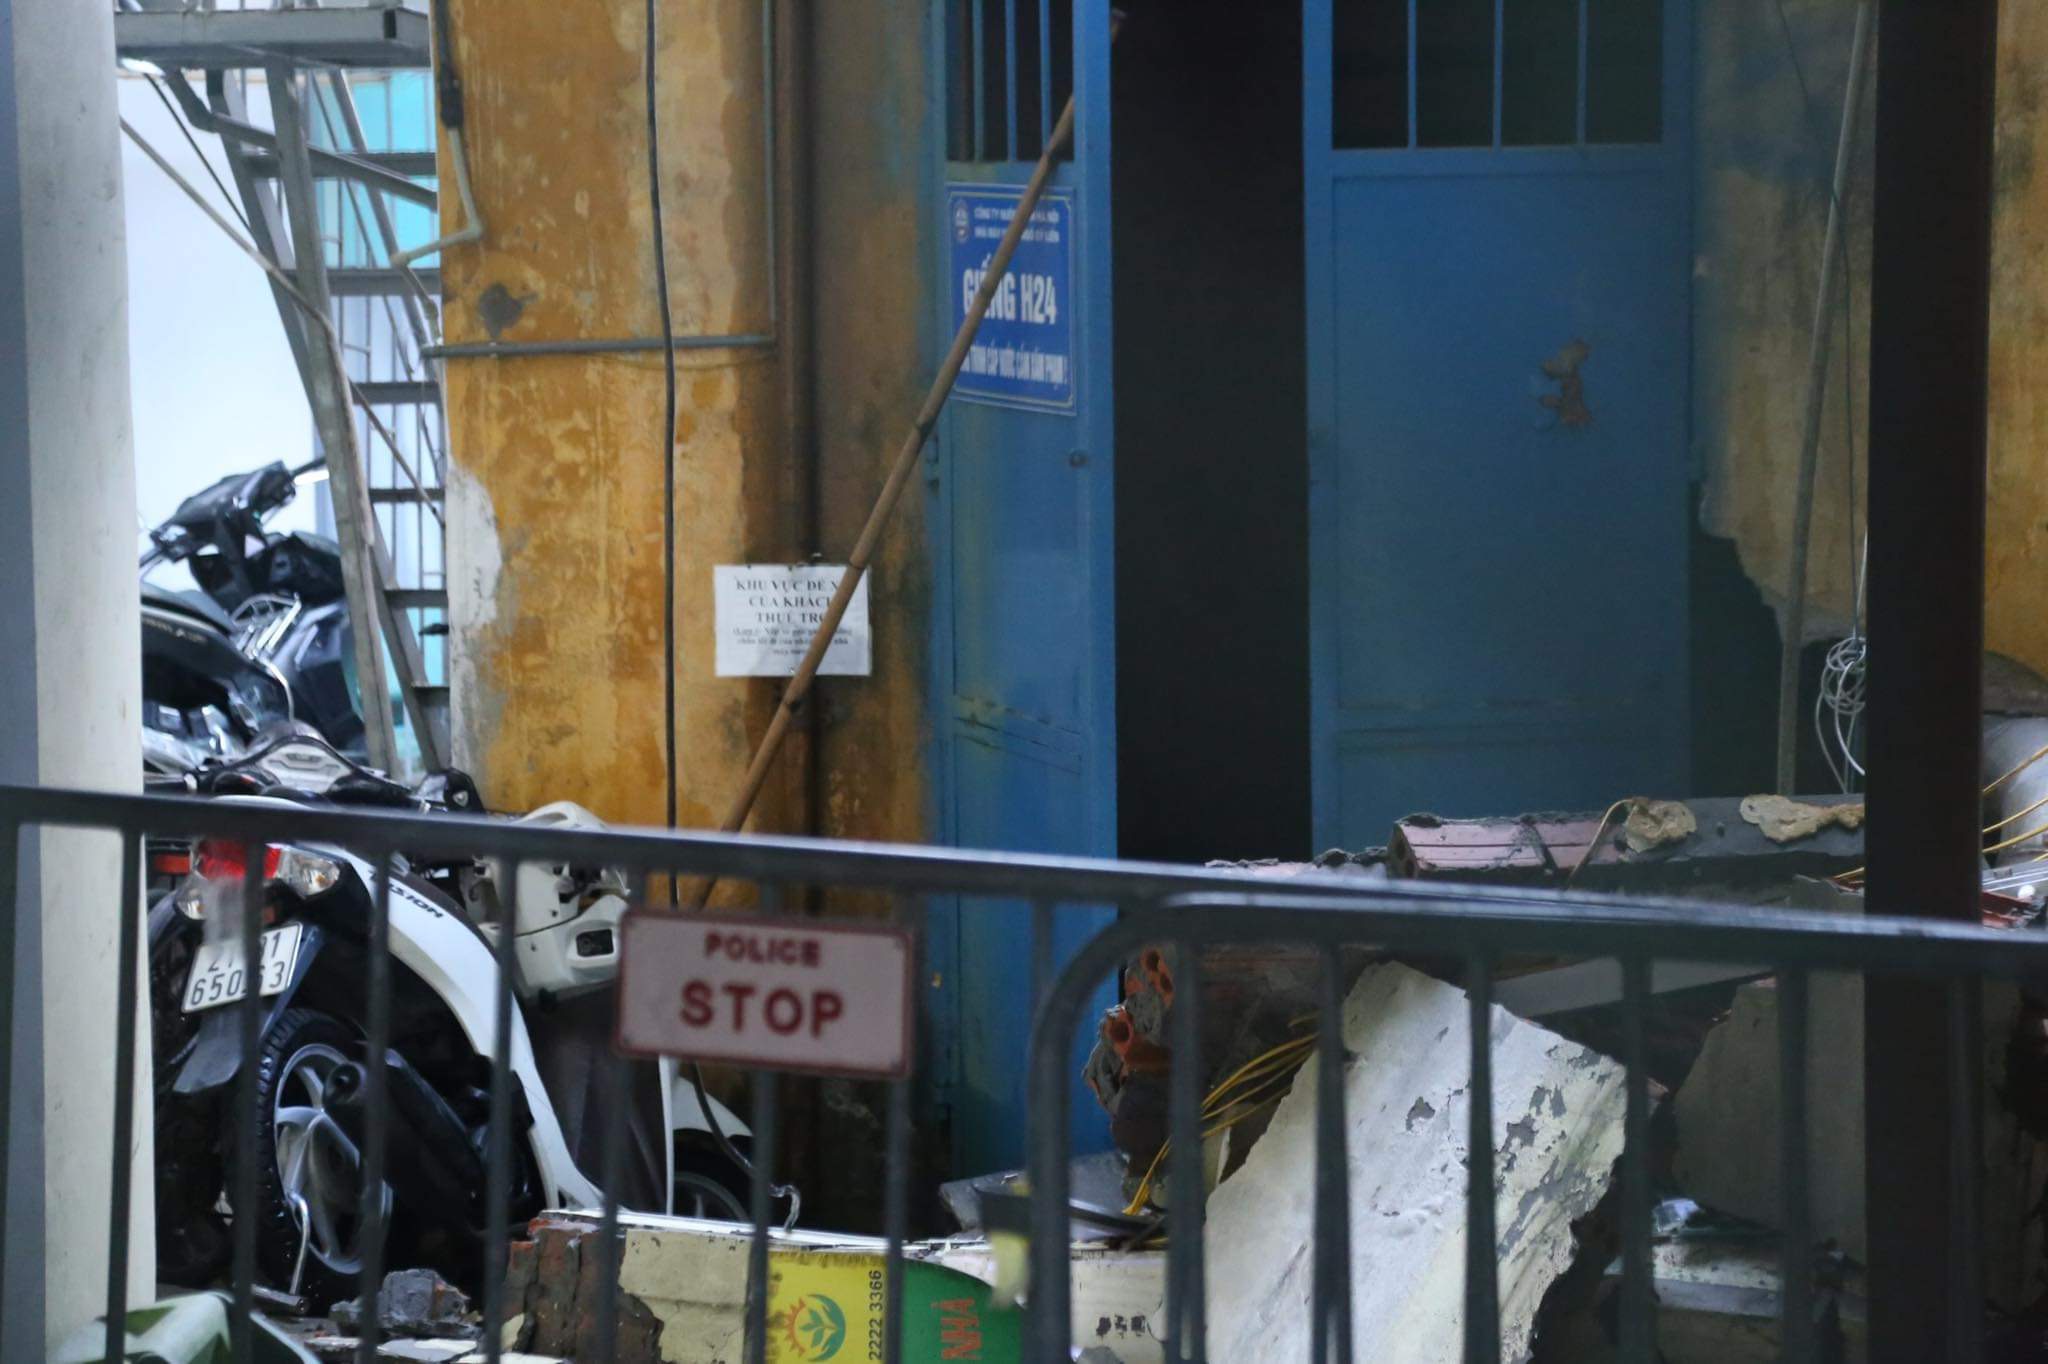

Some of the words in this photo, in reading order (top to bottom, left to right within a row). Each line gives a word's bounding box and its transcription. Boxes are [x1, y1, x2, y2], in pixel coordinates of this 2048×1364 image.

[1020, 273, 1057, 325] H24
[705, 933, 821, 967] POLICE
[679, 980, 843, 1038] STOP
[867, 1269, 884, 1312] 3366
[867, 1318, 884, 1361] 2222
